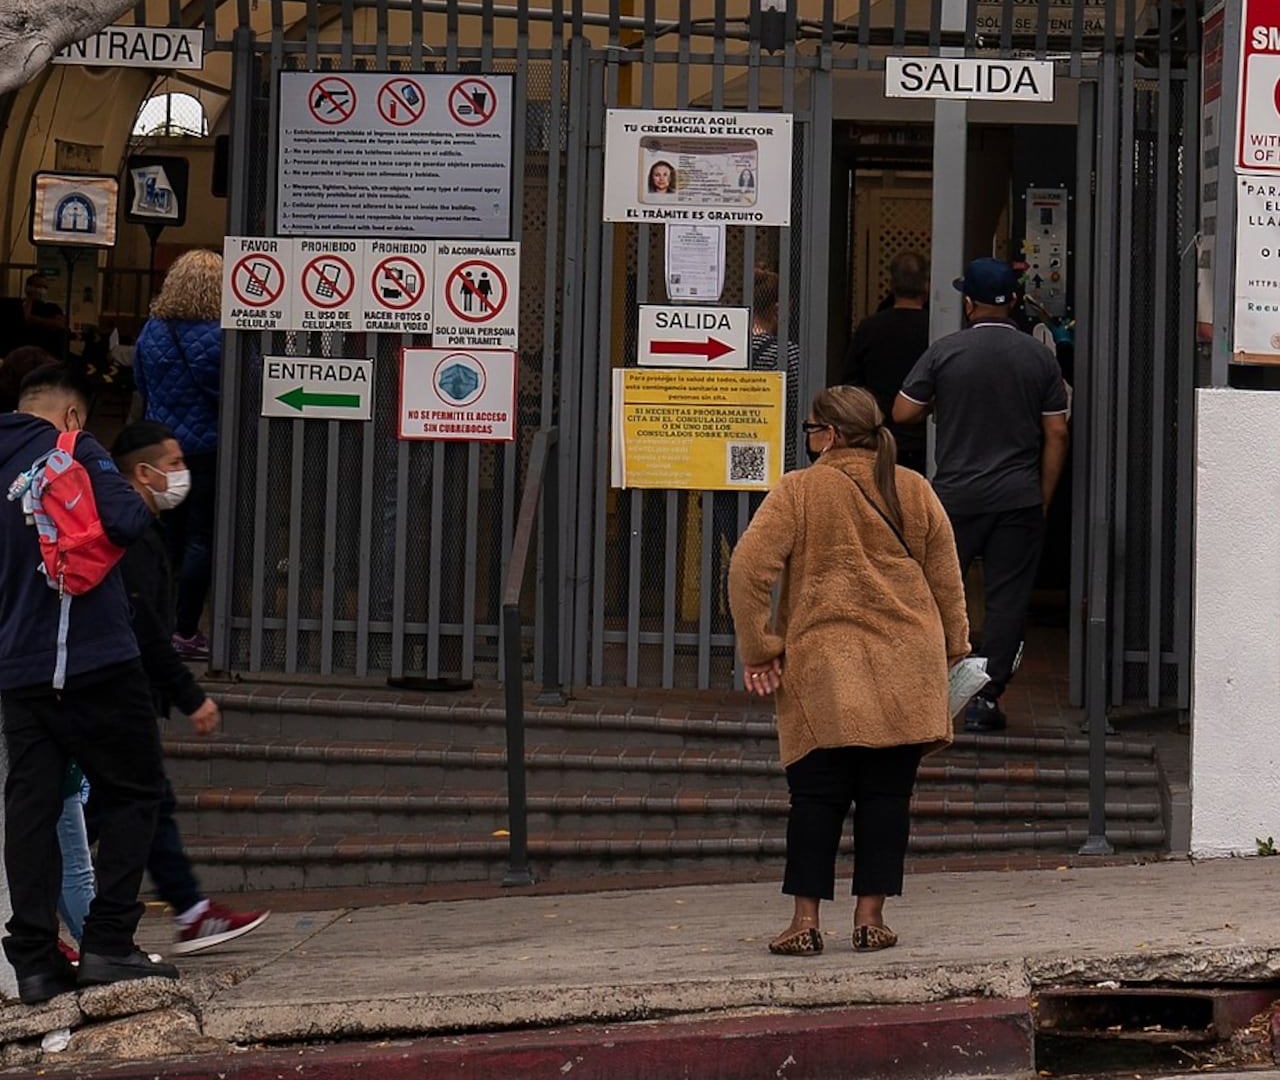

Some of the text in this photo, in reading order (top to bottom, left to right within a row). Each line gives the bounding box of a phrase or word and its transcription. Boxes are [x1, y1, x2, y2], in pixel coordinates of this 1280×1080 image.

[55, 32, 194, 62] NTRADA
[901, 62, 1038, 94] SALIDA
[658, 116, 736, 125] SOLICITA AQUÍ
[624, 124, 637, 132] TU
[641, 125, 706, 134] CREDENCIAL
[727, 127, 773, 135] ELECTOR
[1255, 149, 1274, 161] OF
[1266, 201, 1280, 211] EL
[627, 209, 763, 221] EL TRÁMITE ES GRATUITO
[242, 241, 277, 252] FAVOR
[302, 241, 356, 252] PROHIBIDO
[372, 242, 427, 254] PROHIBIDO
[439, 246, 516, 256] NO ACOMPAÑANTES
[231, 309, 282, 319] APAGAR SU
[305, 311, 350, 319] EL USO DE
[364, 311, 430, 321] HACER FOTOS O
[236, 319, 276, 329] CELULAR
[302, 321, 352, 330] CELULARES
[366, 321, 428, 330] GRABAR VIDEO
[656, 312, 731, 330] SALIDA
[436, 327, 515, 336] SOLO UNA PERSONA
[449, 336, 465, 344] POR
[269, 363, 366, 382] ENTRADA
[409, 411, 507, 421] NO SE PERMITE EL ACCESO
[424, 423, 492, 434] SIN CUBREBOCAS
